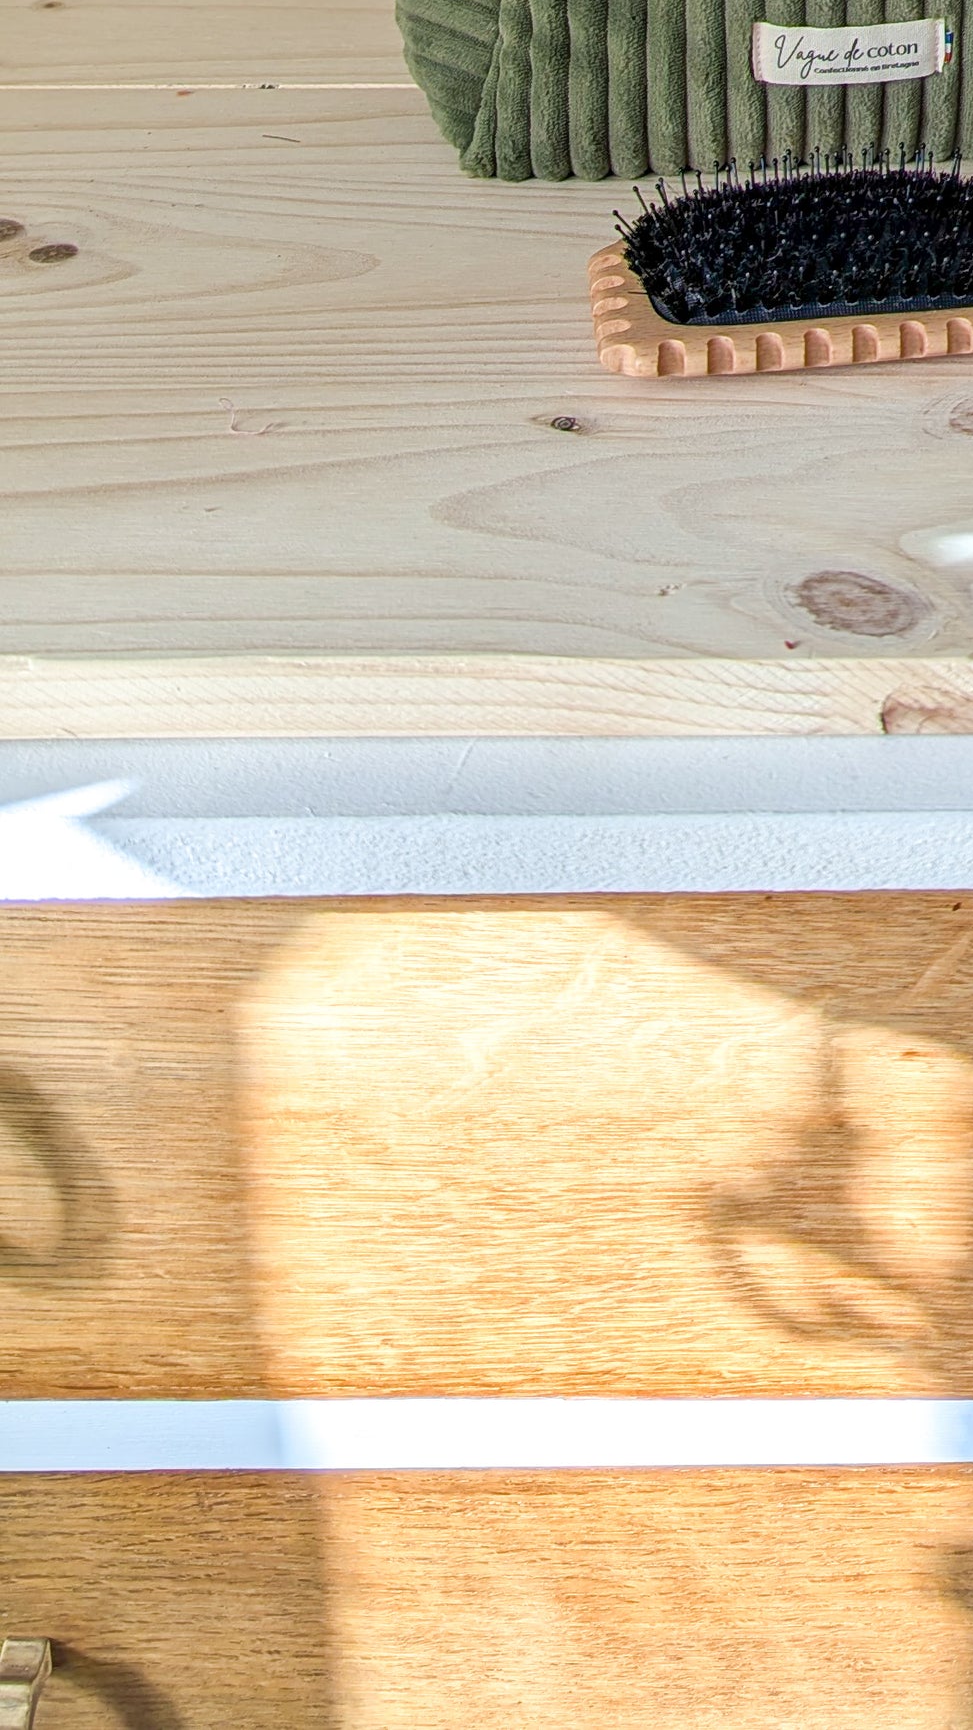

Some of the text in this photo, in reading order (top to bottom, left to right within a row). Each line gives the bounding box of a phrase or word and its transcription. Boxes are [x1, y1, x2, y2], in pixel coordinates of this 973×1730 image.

[775, 34, 918, 79] Vague de coton
[882, 61, 920, 70] Bretagne
